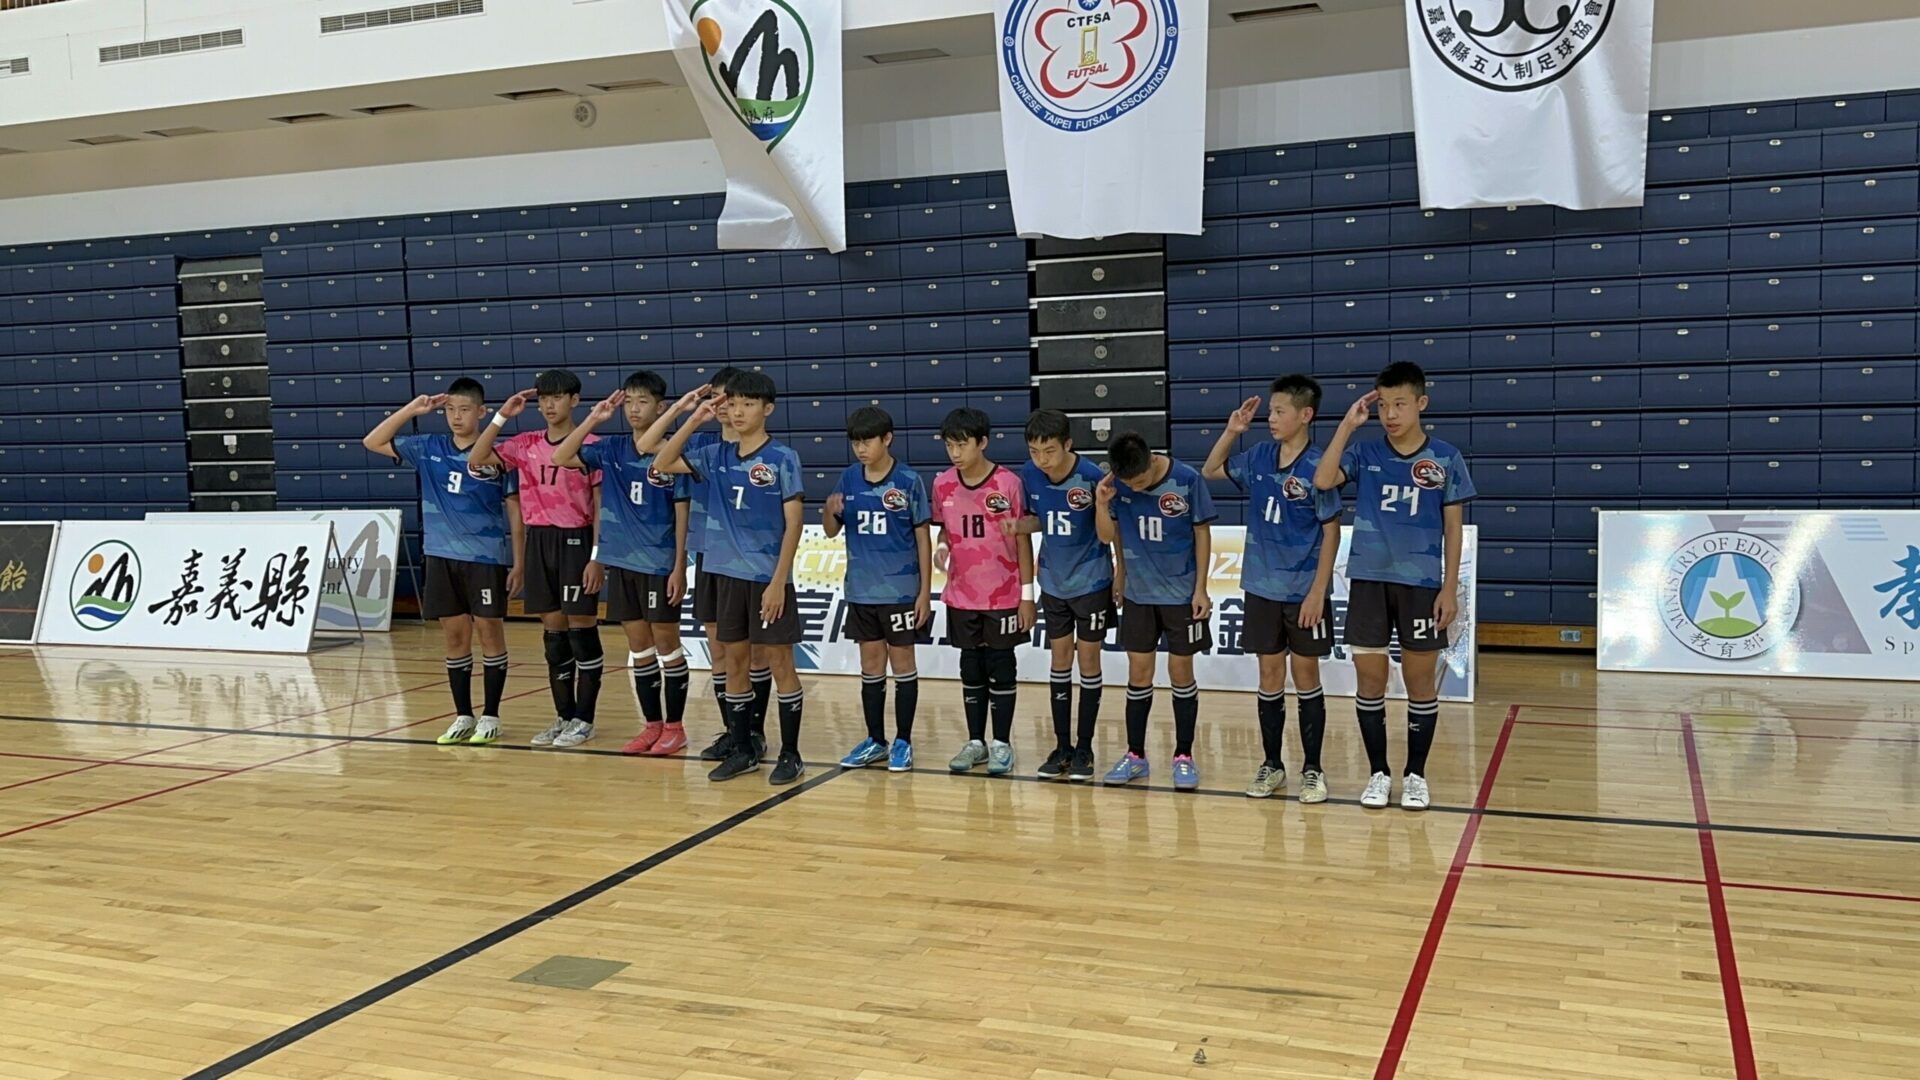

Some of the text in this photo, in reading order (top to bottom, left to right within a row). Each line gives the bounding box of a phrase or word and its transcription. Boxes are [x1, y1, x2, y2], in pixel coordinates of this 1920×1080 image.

[1067, 12, 1111, 28] CTFSA
[1426, 0, 1602, 80] 嘉義縣五人制足球協會
[1067, 63, 1109, 79] FUTSAL
[1011, 65, 1168, 130] CHINESE TAIPEI FUTSAL ASSOCIATION
[447, 471, 462, 494] 9
[540, 465, 560, 485] 17
[631, 481, 643, 505] 8
[732, 486, 744, 510] 7
[1380, 485, 1420, 516] 24
[857, 511, 887, 535] 26
[962, 514, 985, 538] 18
[1047, 511, 1072, 536] 15
[1138, 515, 1163, 542] 10
[148, 545, 310, 630] 嘉義縣
[563, 585, 581, 603] 17
[1663, 546, 1700, 630] MINISTRY
[1703, 537, 1729, 552] OF
[482, 589, 492, 605] 9
[890, 612, 915, 633] 26
[1000, 614, 1018, 635] 18
[1089, 610, 1107, 631] 15
[1187, 621, 1203, 644] 10
